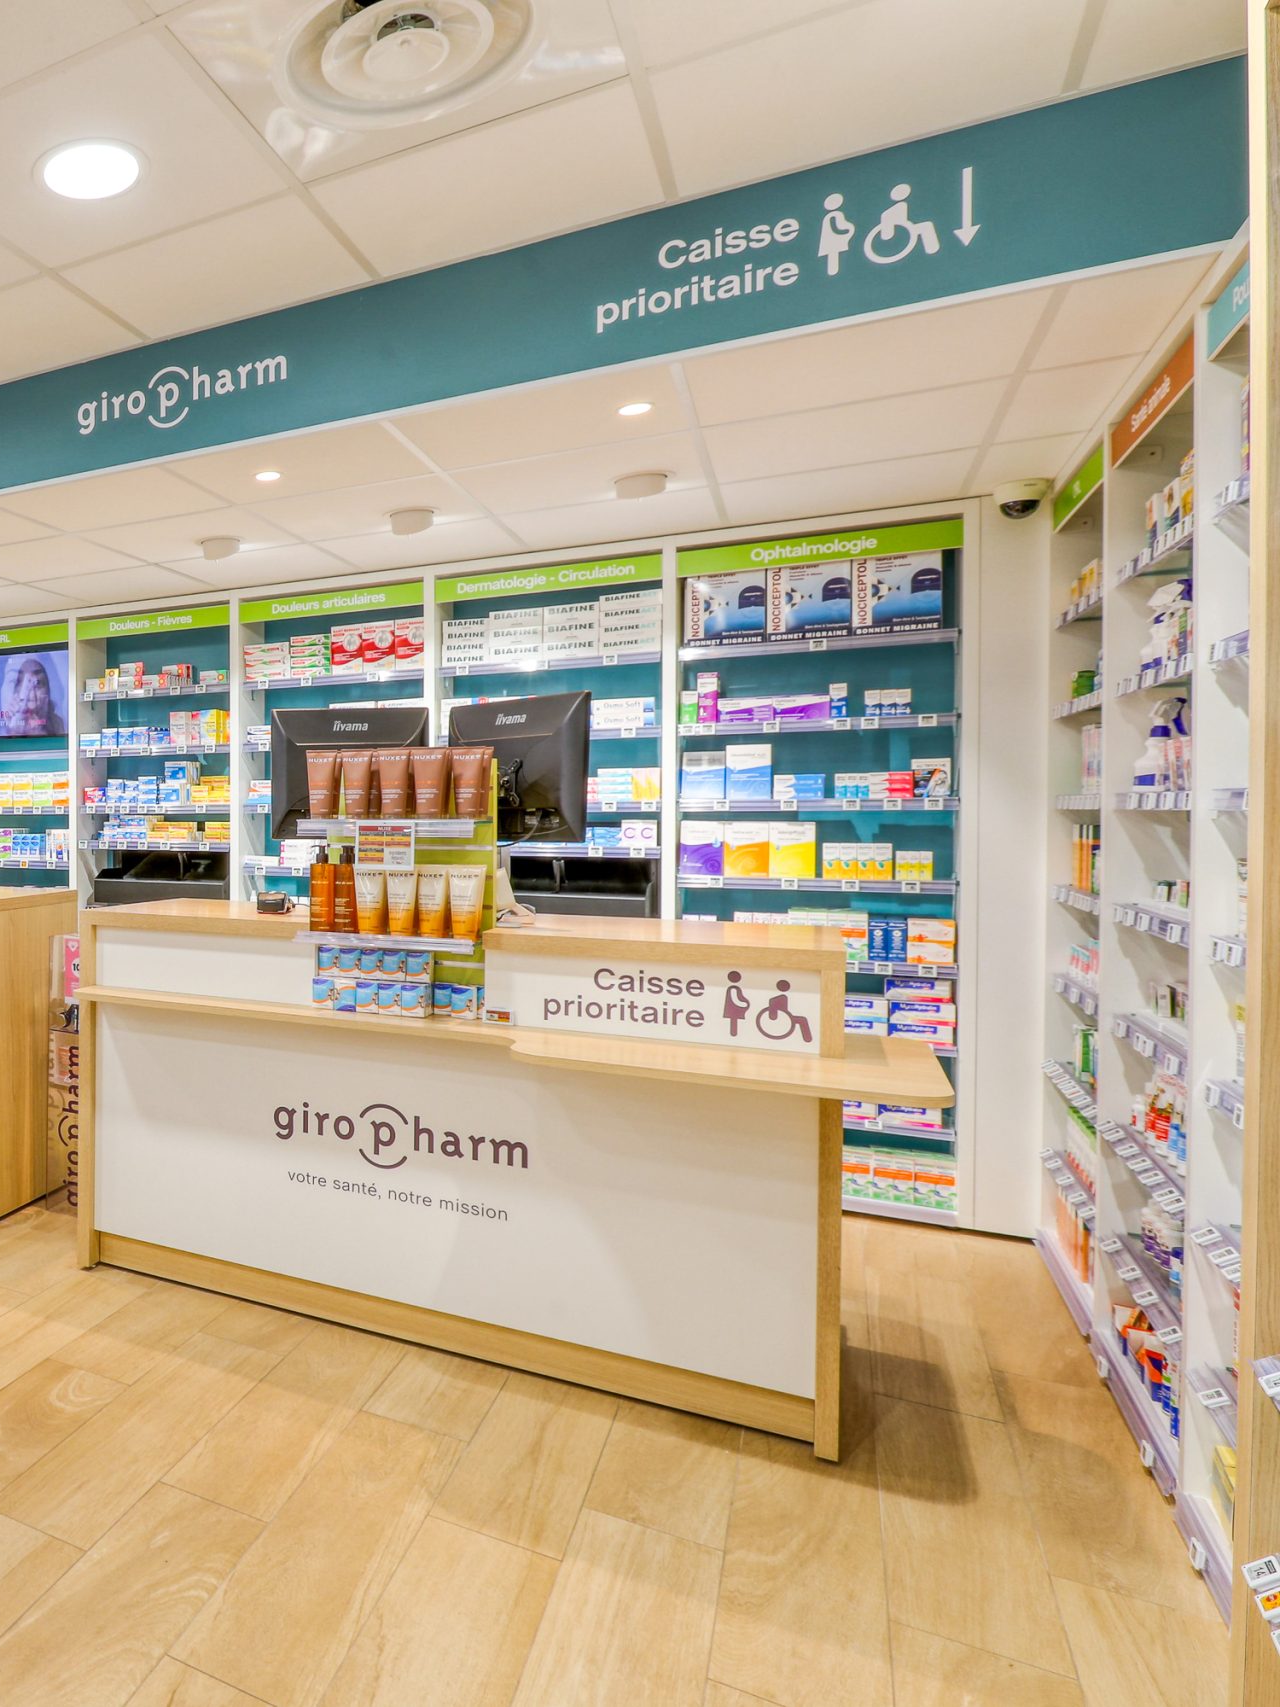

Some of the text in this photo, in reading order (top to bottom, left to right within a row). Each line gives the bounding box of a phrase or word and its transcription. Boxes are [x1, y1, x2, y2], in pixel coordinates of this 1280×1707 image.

[658, 218, 799, 269] Caisse
[596, 262, 799, 333] prioritaire
[77, 355, 288, 435] giropharm
[750, 536, 878, 563] Ophtalmologie
[456, 574, 546, 595] Dermatologie
[558, 563, 636, 583] Circulation
[857, 558, 868, 625] NOCICEPTOL
[271, 591, 386, 615] Douleurs articulaires
[548, 604, 595, 615] BIAFINE
[493, 610, 539, 621] BIAFINE
[109, 620, 150, 632] Douleurs
[447, 619, 485, 628] BIAFINE
[547, 622, 595, 633] BIAFINE
[856, 623, 939, 635] BONNET MIGRAINE
[447, 631, 485, 639] BIAFINE
[493, 628, 539, 638] BIAFINE
[770, 629, 848, 641] BONNET MIGRAINE
[547, 641, 595, 651] BIAFINE
[722, 636, 763, 645] MIGRAINE
[446, 643, 484, 651] BIAFINE
[494, 645, 539, 656] BIAFINE
[446, 654, 484, 663] BIAFINE
[413, 753, 437, 761] NUXE
[453, 753, 476, 761] NUXE
[450, 872, 473, 880] NUXE
[593, 967, 705, 998] Caisse
[543, 994, 705, 1028] prioritaire
[273, 1102, 529, 1169] giropharm
[287, 1170, 509, 1222] votre santé, notre mission
